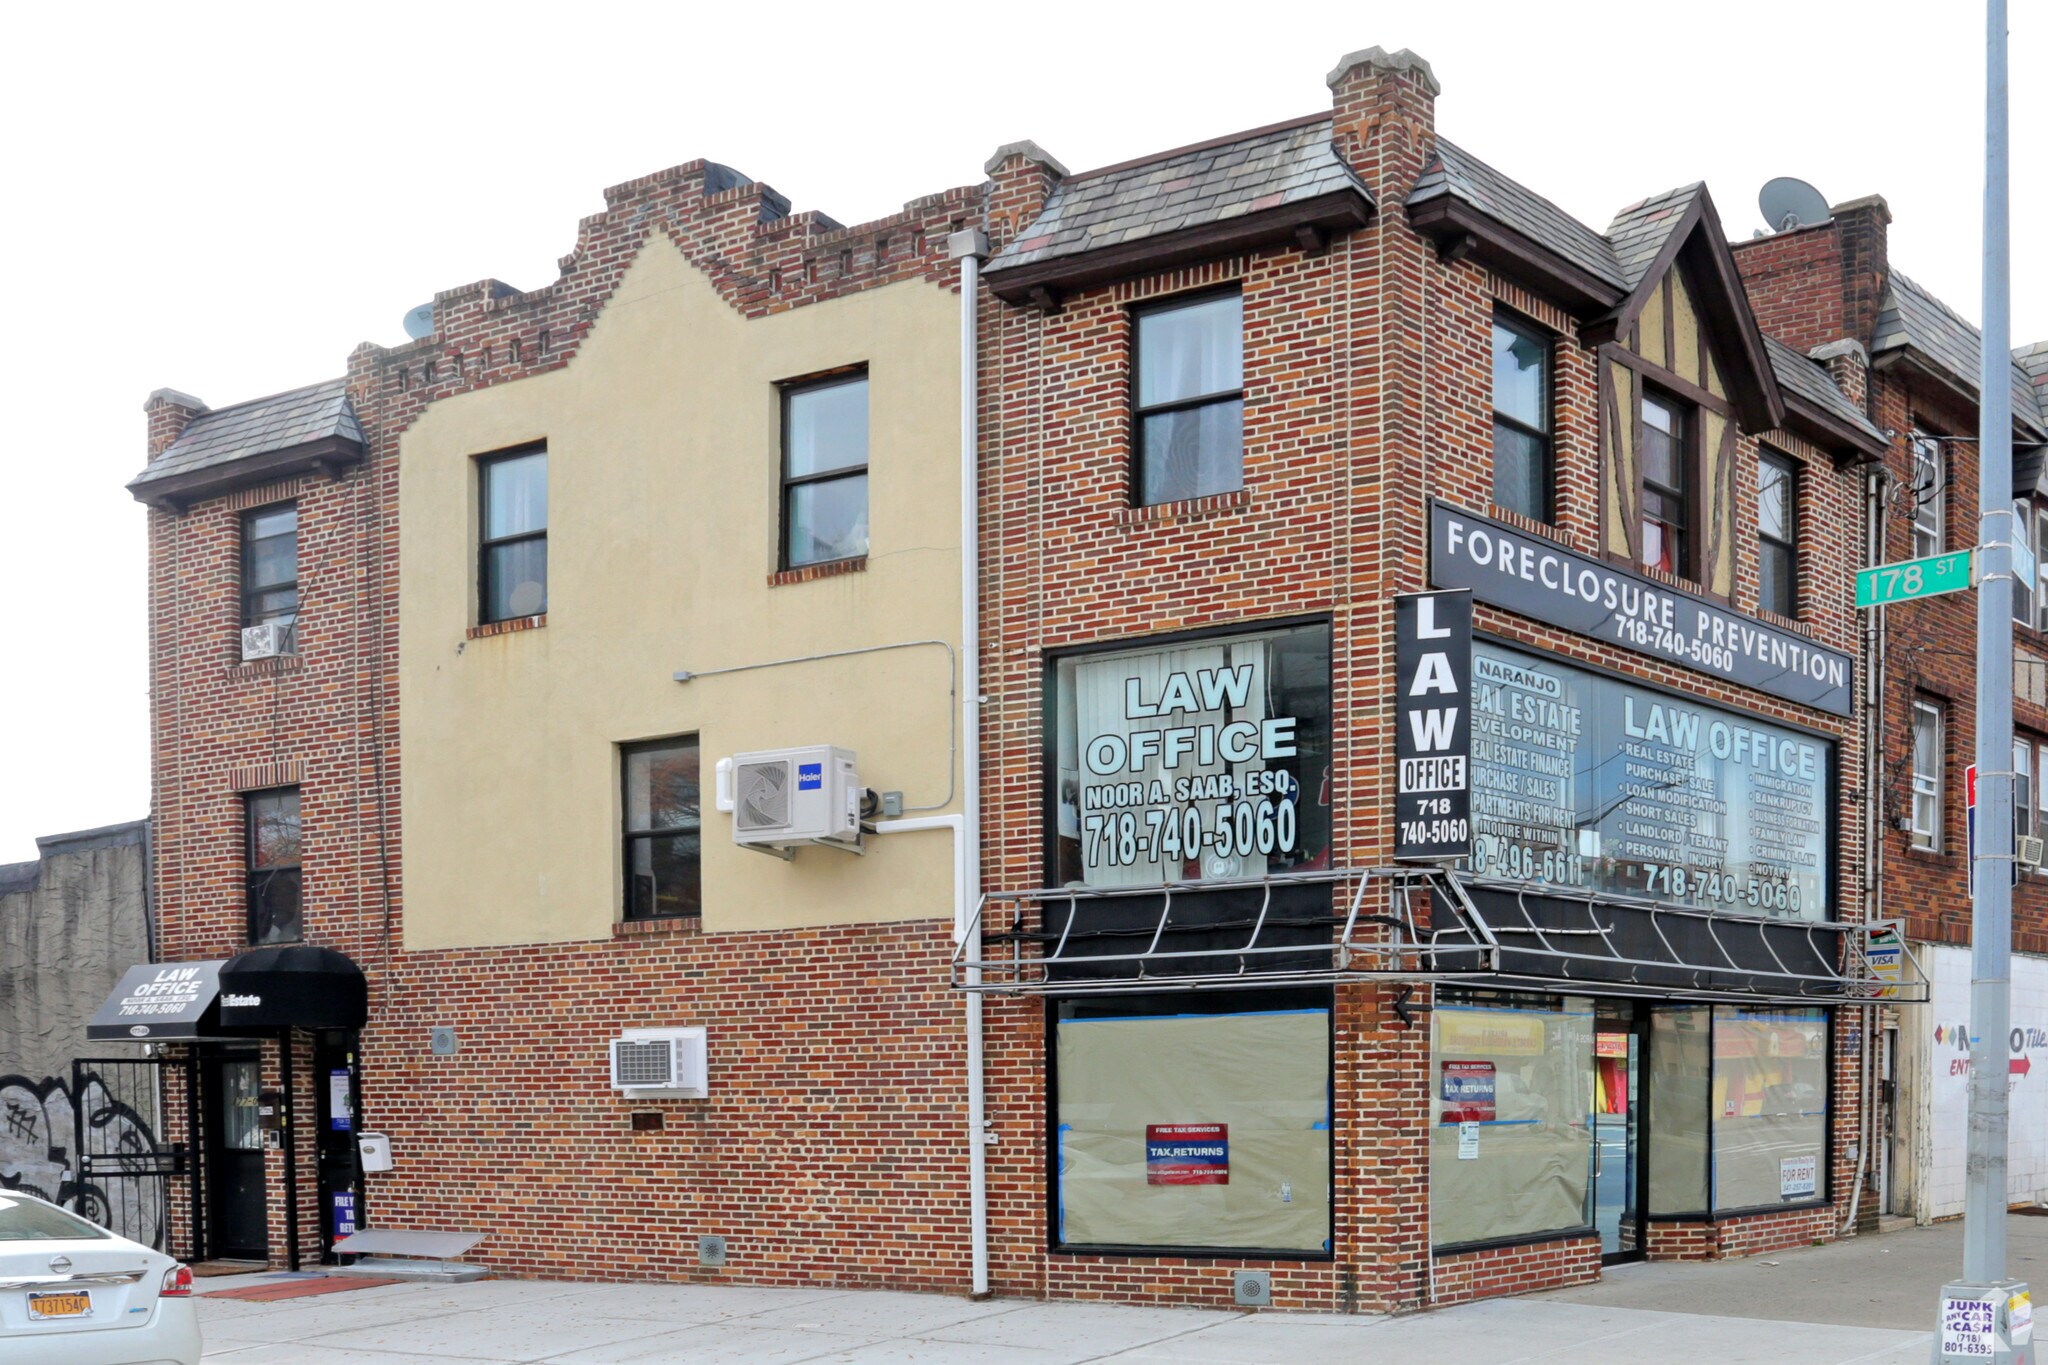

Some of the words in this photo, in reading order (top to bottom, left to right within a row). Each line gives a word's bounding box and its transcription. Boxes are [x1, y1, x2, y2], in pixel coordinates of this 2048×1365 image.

[1868, 564, 1924, 601] 178
[1936, 557, 1957, 575] ST
[1448, 520, 1674, 629] FORECLOSURE
[1697, 611, 1844, 687] PREVENTION
[1615, 613, 1733, 672] 718-740-5060
[1480, 661, 1556, 693] NARANJO
[1125, 664, 1254, 720] LAW
[1511, 691, 1581, 736] ESTATE
[1086, 717, 1297, 775] OFFICE
[1624, 695, 1700, 752] LAW
[1709, 721, 1815, 781] OFFICE
[1471, 738, 1491, 762] EAL
[1494, 743, 1528, 770] ESTATE
[1530, 751, 1570, 779] FINANCE
[1625, 742, 1654, 760] REAL
[1656, 749, 1694, 770] ESTATE
[799, 772, 822, 782] Haier
[1405, 758, 1460, 791] OFFICE
[1471, 765, 1518, 793] URCHASE
[1526, 776, 1556, 801] SALES
[1689, 776, 1714, 793] SALE
[1754, 773, 1812, 798] IMMIGRATION
[1086, 782, 1143, 810] NOOR
[1149, 780, 1170, 805] A.
[1175, 774, 1241, 802] SAAB,
[1246, 769, 1296, 797] ESQ.
[1625, 782, 1654, 800] LOAN
[1657, 789, 1727, 815] MODIFICATION
[1417, 798, 1451, 816] 718
[1625, 802, 1662, 820] SHORT
[1664, 809, 1697, 828] SALES
[1754, 790, 1813, 815] BANKRUPTCY
[1533, 803, 1551, 825] FOR
[1553, 808, 1577, 829] RENT
[1754, 809, 1785, 827] BUSINESS
[1085, 799, 1296, 868] 718-740-5060
[1401, 818, 1467, 845] 740-5060
[1480, 820, 1520, 839] INQUIRE
[1522, 826, 1558, 844] WITHIN
[1689, 833, 1729, 853] TENANT
[1755, 826, 1786, 844] FAMILY
[1787, 832, 1806, 848] LAW
[1625, 841, 1682, 863] PERSONAL
[1688, 851, 1725, 869] INJURY
[1755, 844, 1798, 864] CRIMINAL
[1798, 851, 1817, 867] LAW
[1755, 862, 1791, 880] NOTARY
[1643, 863, 1801, 912] 718-740-5060
[1872, 956, 1893, 965] VISA
[154, 967, 200, 982] LAW
[134, 981, 203, 996] OFFICE
[118, 1003, 187, 1016] 718-740-5060
[1445, 1084, 1459, 1093] TAX
[1460, 1084, 1493, 1093] RETURNS
[1150, 1147, 1171, 1156] TAX
[1173, 1147, 1224, 1156] RETURNS
[1783, 1168, 1796, 1182] FOR
[1797, 1167, 1814, 1180] RENT
[1946, 1312, 1961, 1322] ANY
[1961, 1312, 1993, 1322] CAR
[1947, 1301, 1993, 1312] JUNK
[1946, 1323, 1952, 1331] 4
[1953, 1322, 1993, 1333] CA$H
[1957, 1333, 1981, 1343] (718)
[1944, 1342, 1992, 1354] 801-6395
